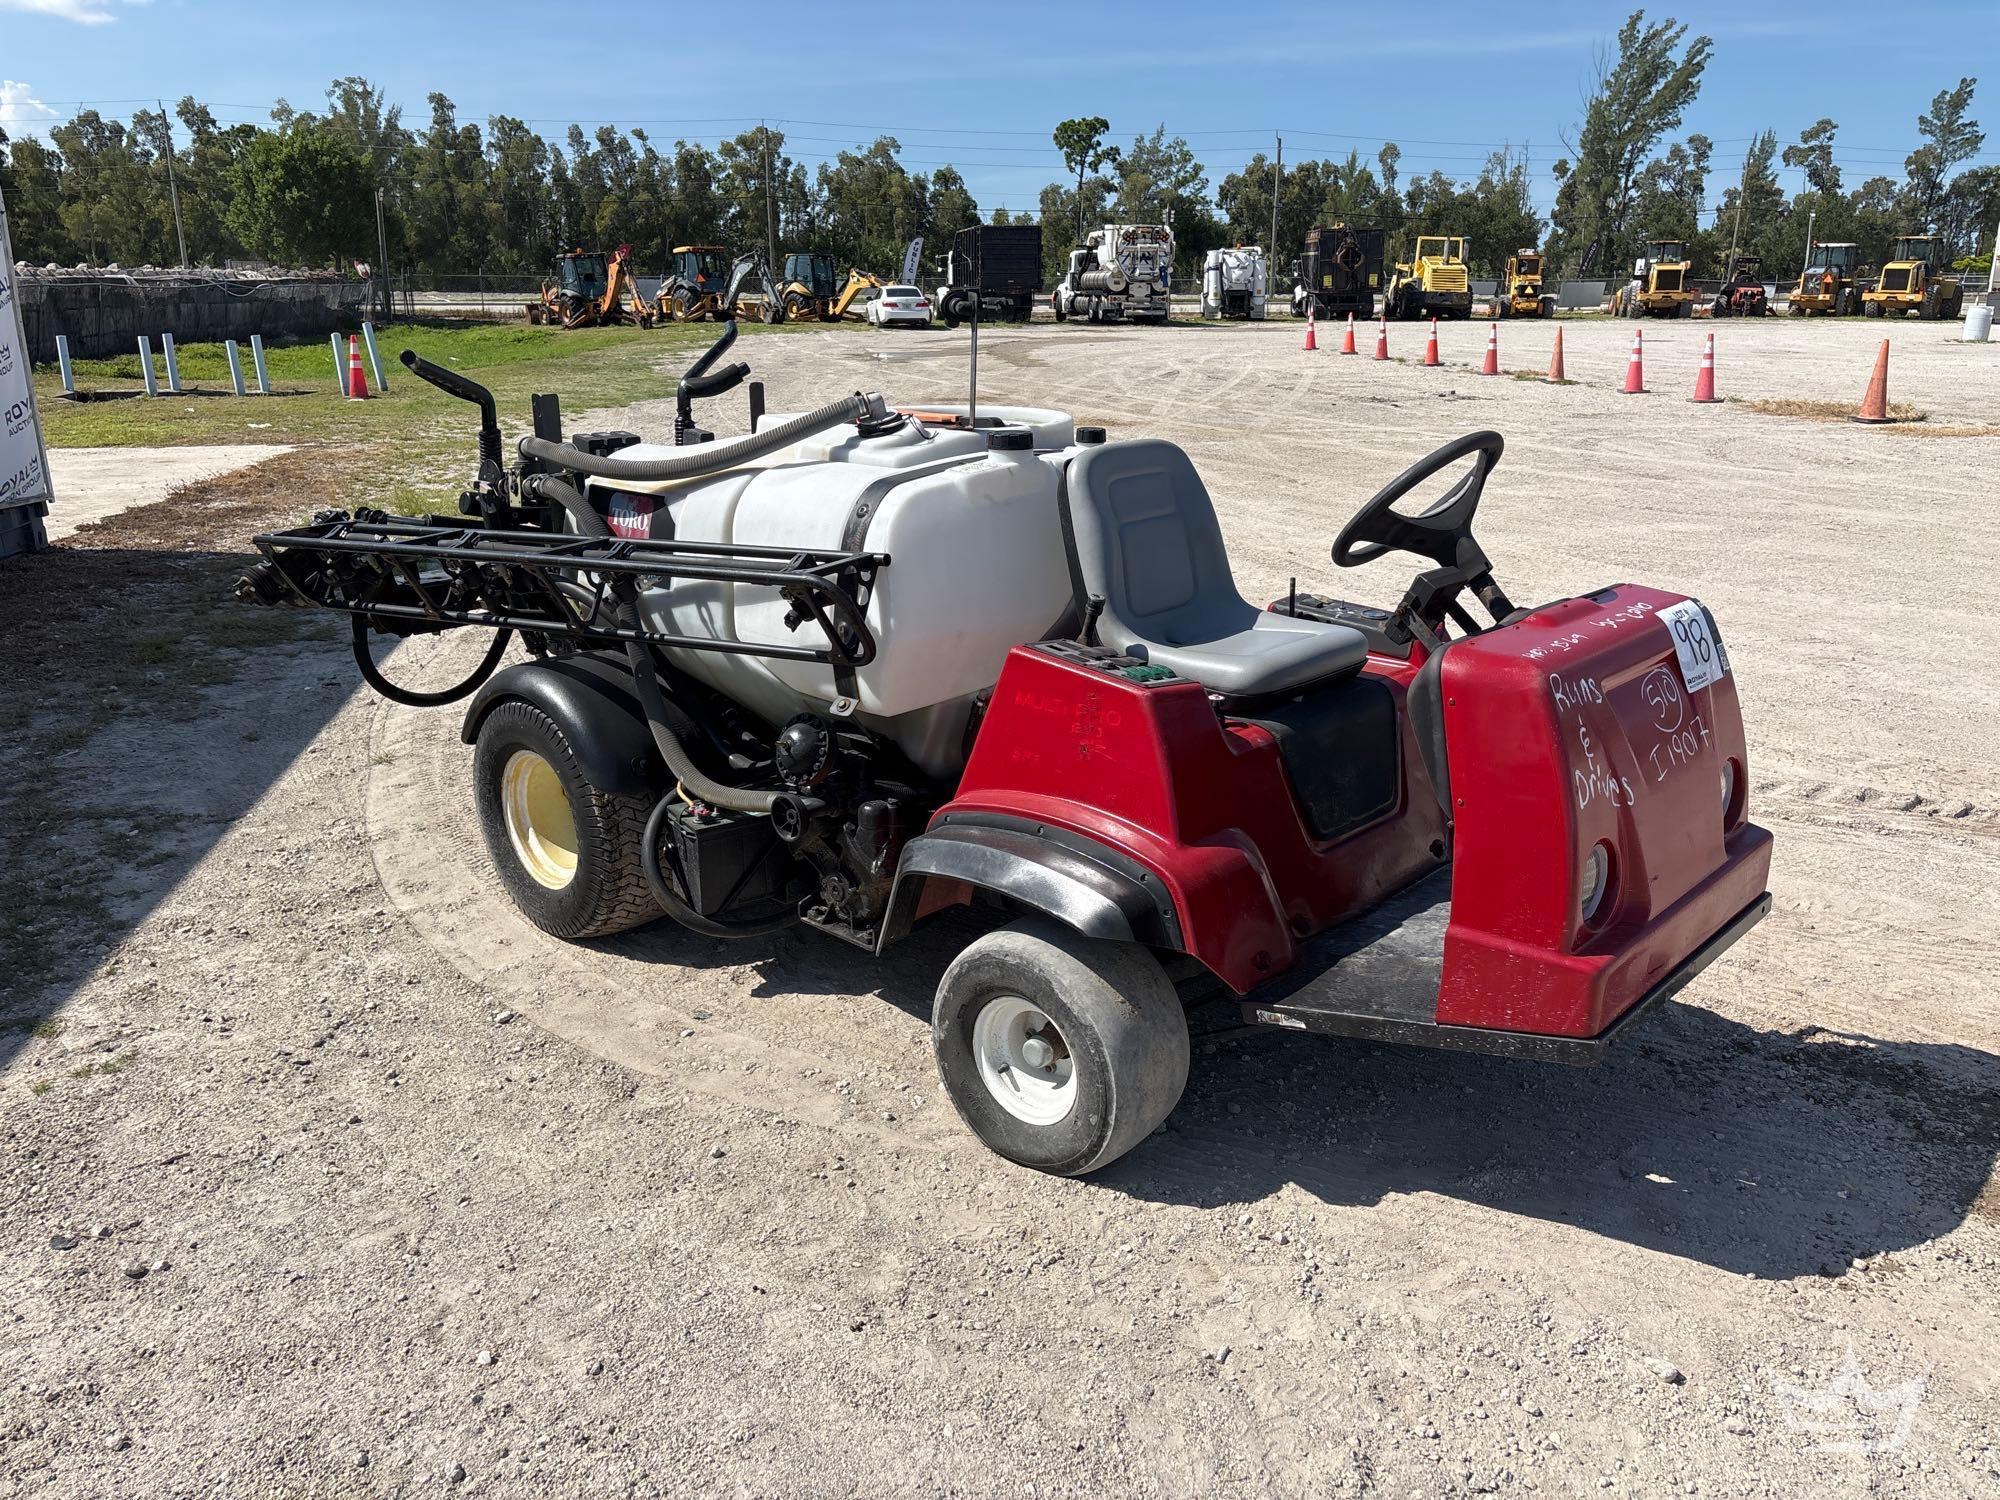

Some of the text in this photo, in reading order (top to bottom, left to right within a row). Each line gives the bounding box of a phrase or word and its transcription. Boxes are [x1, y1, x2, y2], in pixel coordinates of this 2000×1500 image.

[908, 241, 920, 273] PUBLIC
[4, 398, 29, 426] ROY
[0, 466, 30, 496] OYAL
[612, 508, 648, 531] TORO
[1674, 618, 1711, 666] 98
[1646, 674, 1680, 719] 510
